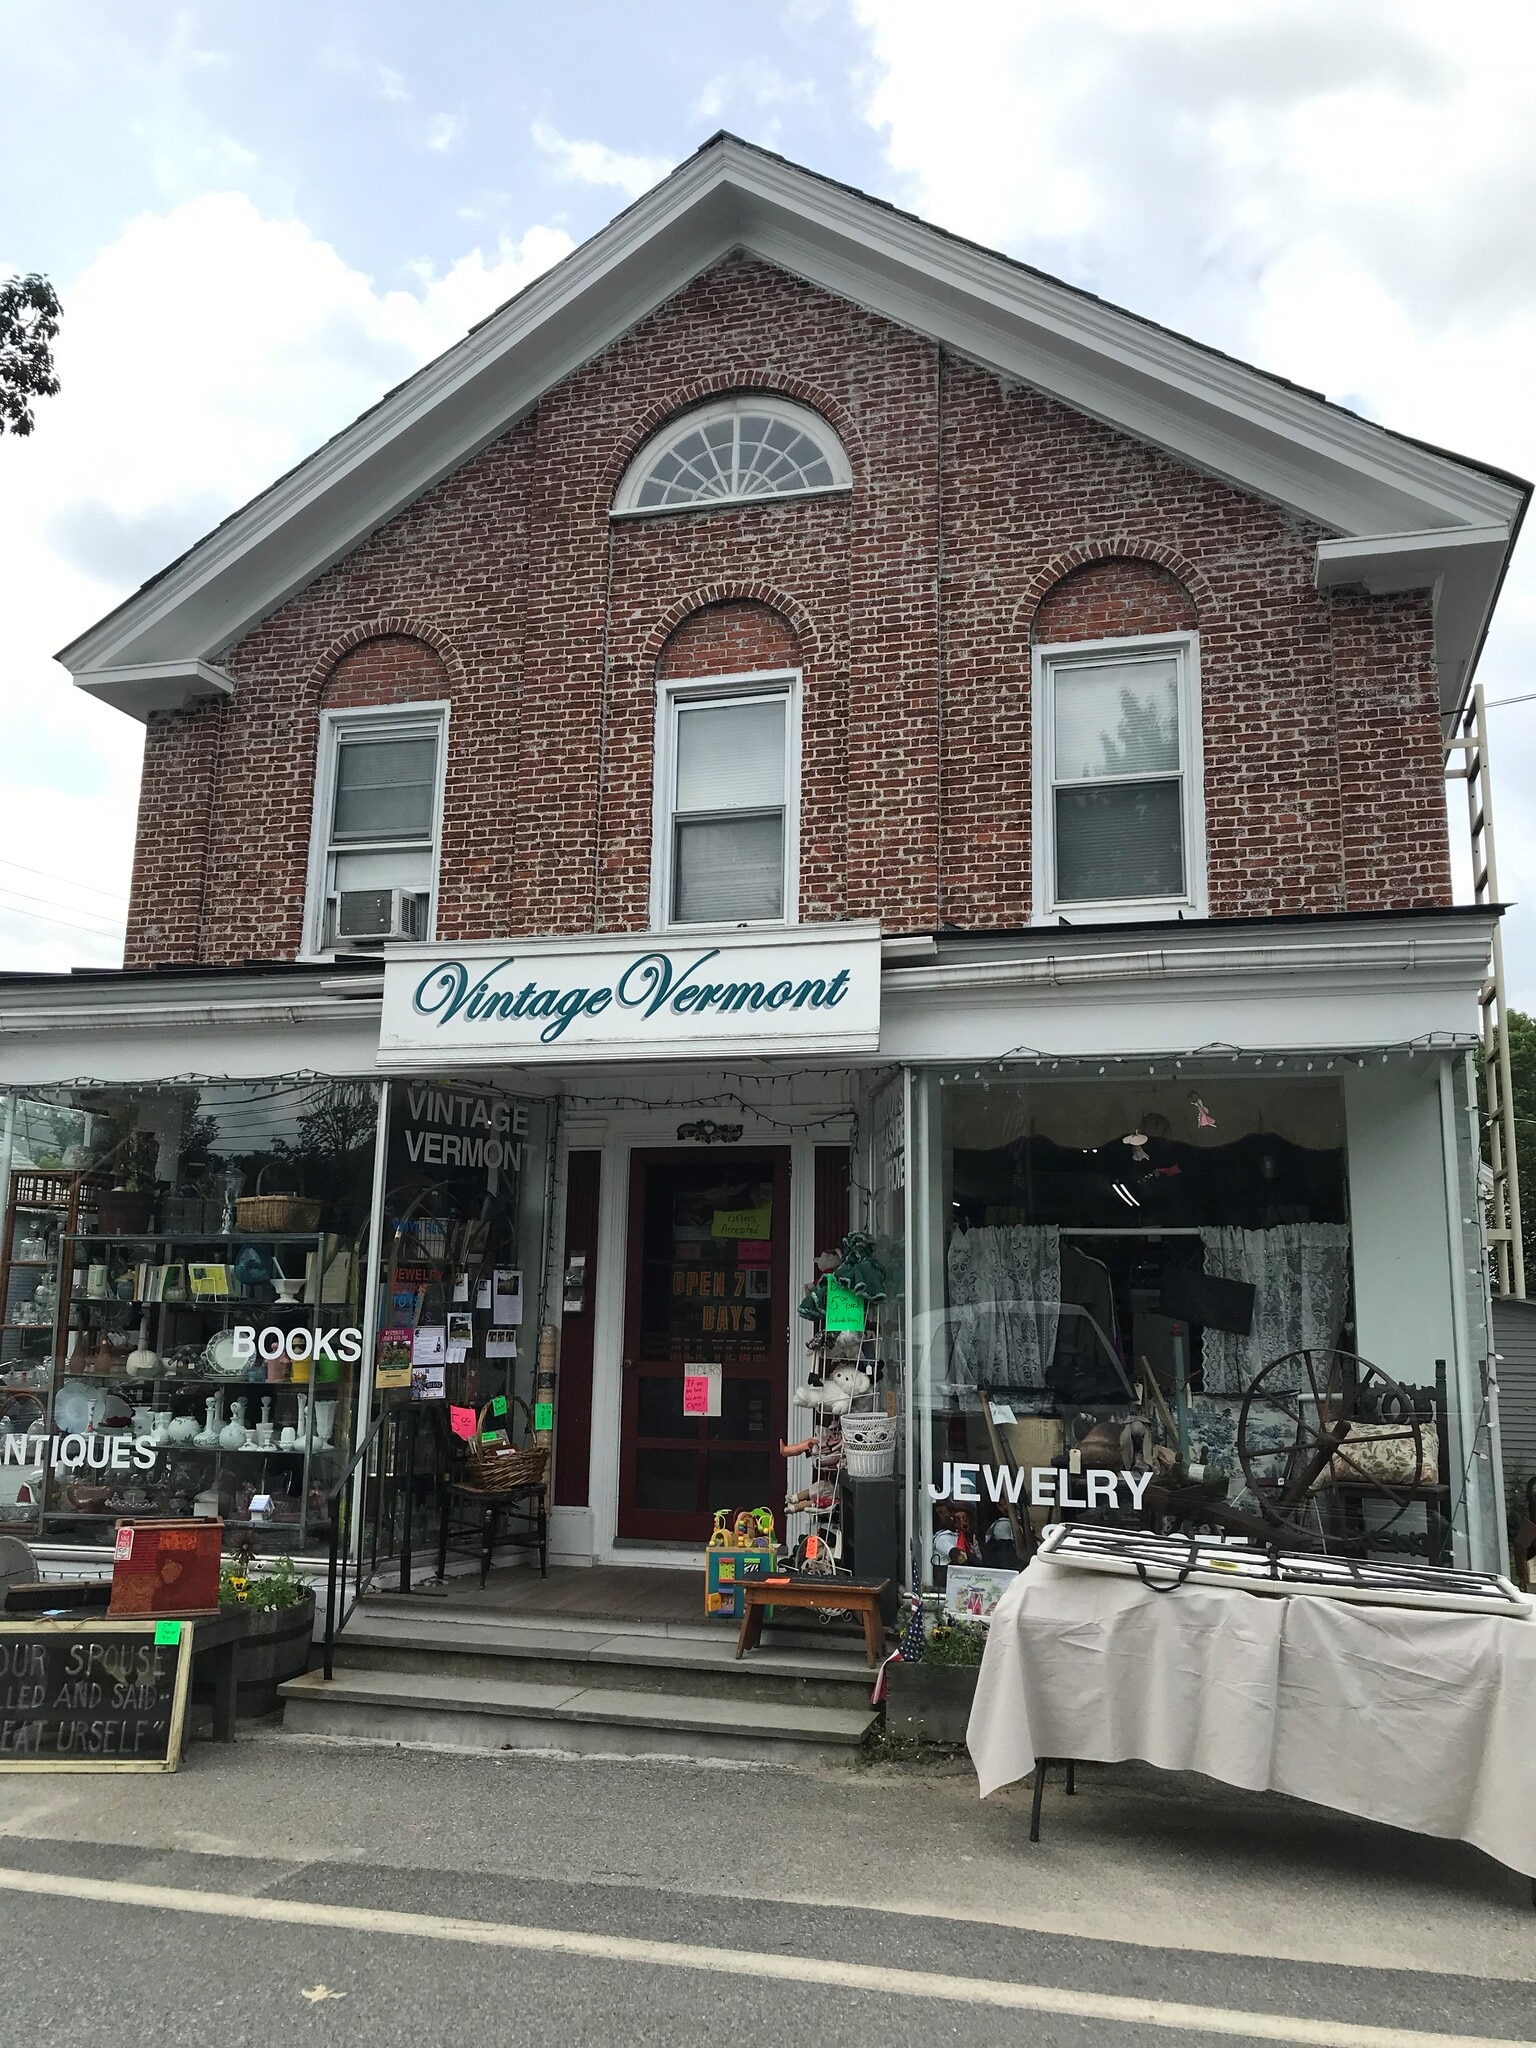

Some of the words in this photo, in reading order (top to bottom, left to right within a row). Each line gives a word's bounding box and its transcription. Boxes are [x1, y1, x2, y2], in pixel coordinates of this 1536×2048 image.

[412, 957, 613, 1043] Vintage
[617, 949, 851, 1019] Vermont
[407, 1087, 529, 1136] VINTAGE
[405, 1129, 539, 1172] VERMONT
[720, 1223, 760, 1234] Accepted
[393, 1267, 444, 1281] JEWELRY
[673, 1271, 726, 1297] OPEN
[734, 1271, 746, 1297] 7
[392, 1295, 422, 1307] TOYS
[702, 1305, 756, 1332] DAYS
[232, 1325, 363, 1364] BOOKS
[0, 1433, 157, 1472] NTIQUES
[927, 1461, 1154, 1512] JEWELRY
[65, 1643, 168, 1680] SPOUSE
[0, 1684, 46, 1710] LED
[53, 1682, 103, 1710] AND
